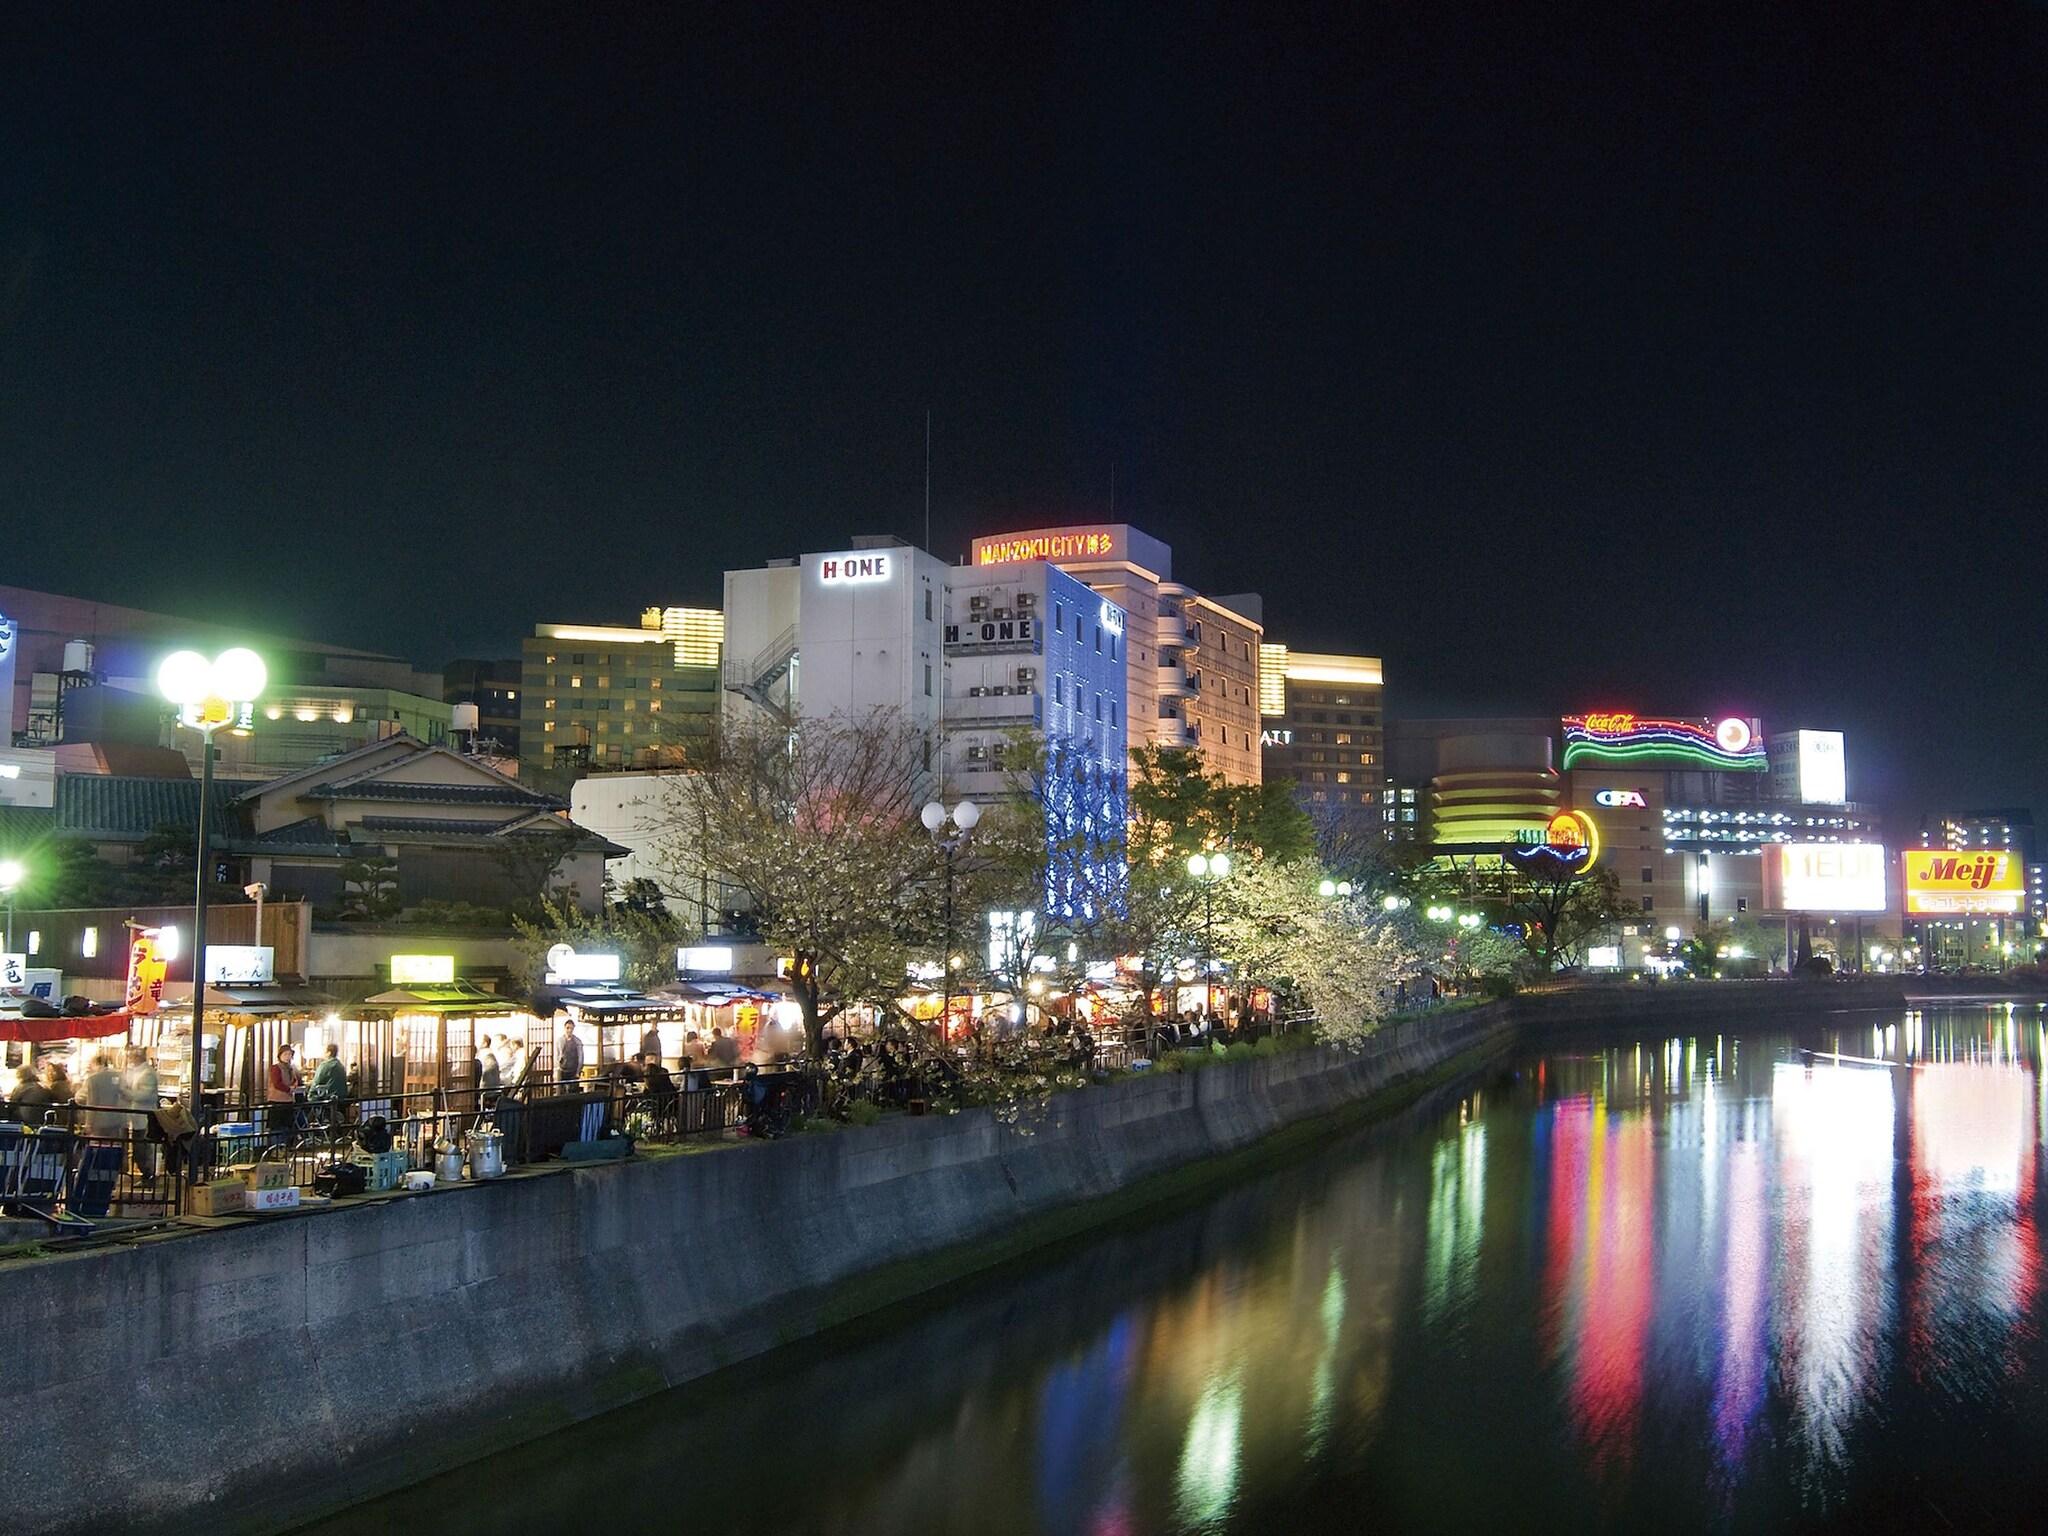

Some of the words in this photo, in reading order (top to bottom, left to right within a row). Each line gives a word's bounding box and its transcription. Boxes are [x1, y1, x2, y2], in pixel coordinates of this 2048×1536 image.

[1051, 534, 1085, 557] CITY
[1087, 533, 1113, 555] 博多
[1920, 856, 2008, 889] Meiji
